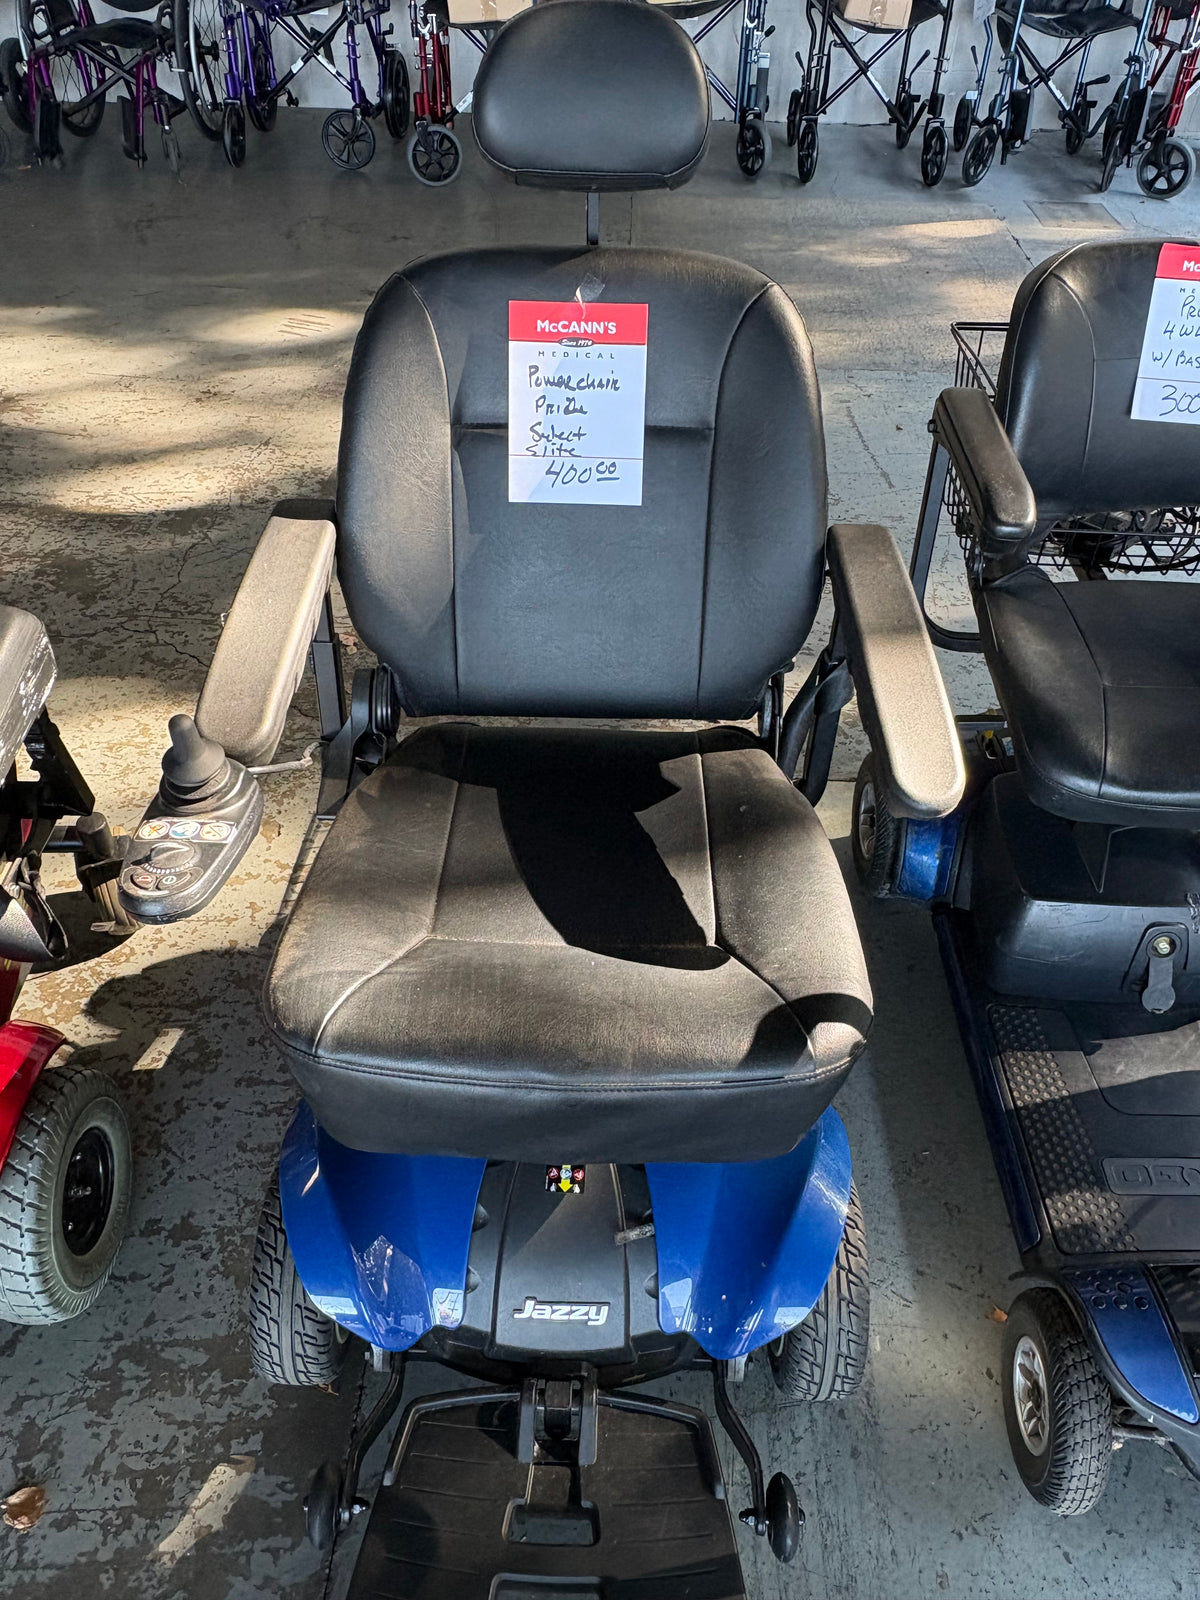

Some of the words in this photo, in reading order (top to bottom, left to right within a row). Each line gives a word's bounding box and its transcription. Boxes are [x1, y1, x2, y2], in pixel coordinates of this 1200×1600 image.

[536, 319, 617, 334] McCANN'S
[1163, 320, 1176, 340] 4
[538, 350, 615, 360] MEDICAL
[529, 421, 587, 442] Select
[513, 1297, 610, 1326] Jazzy
